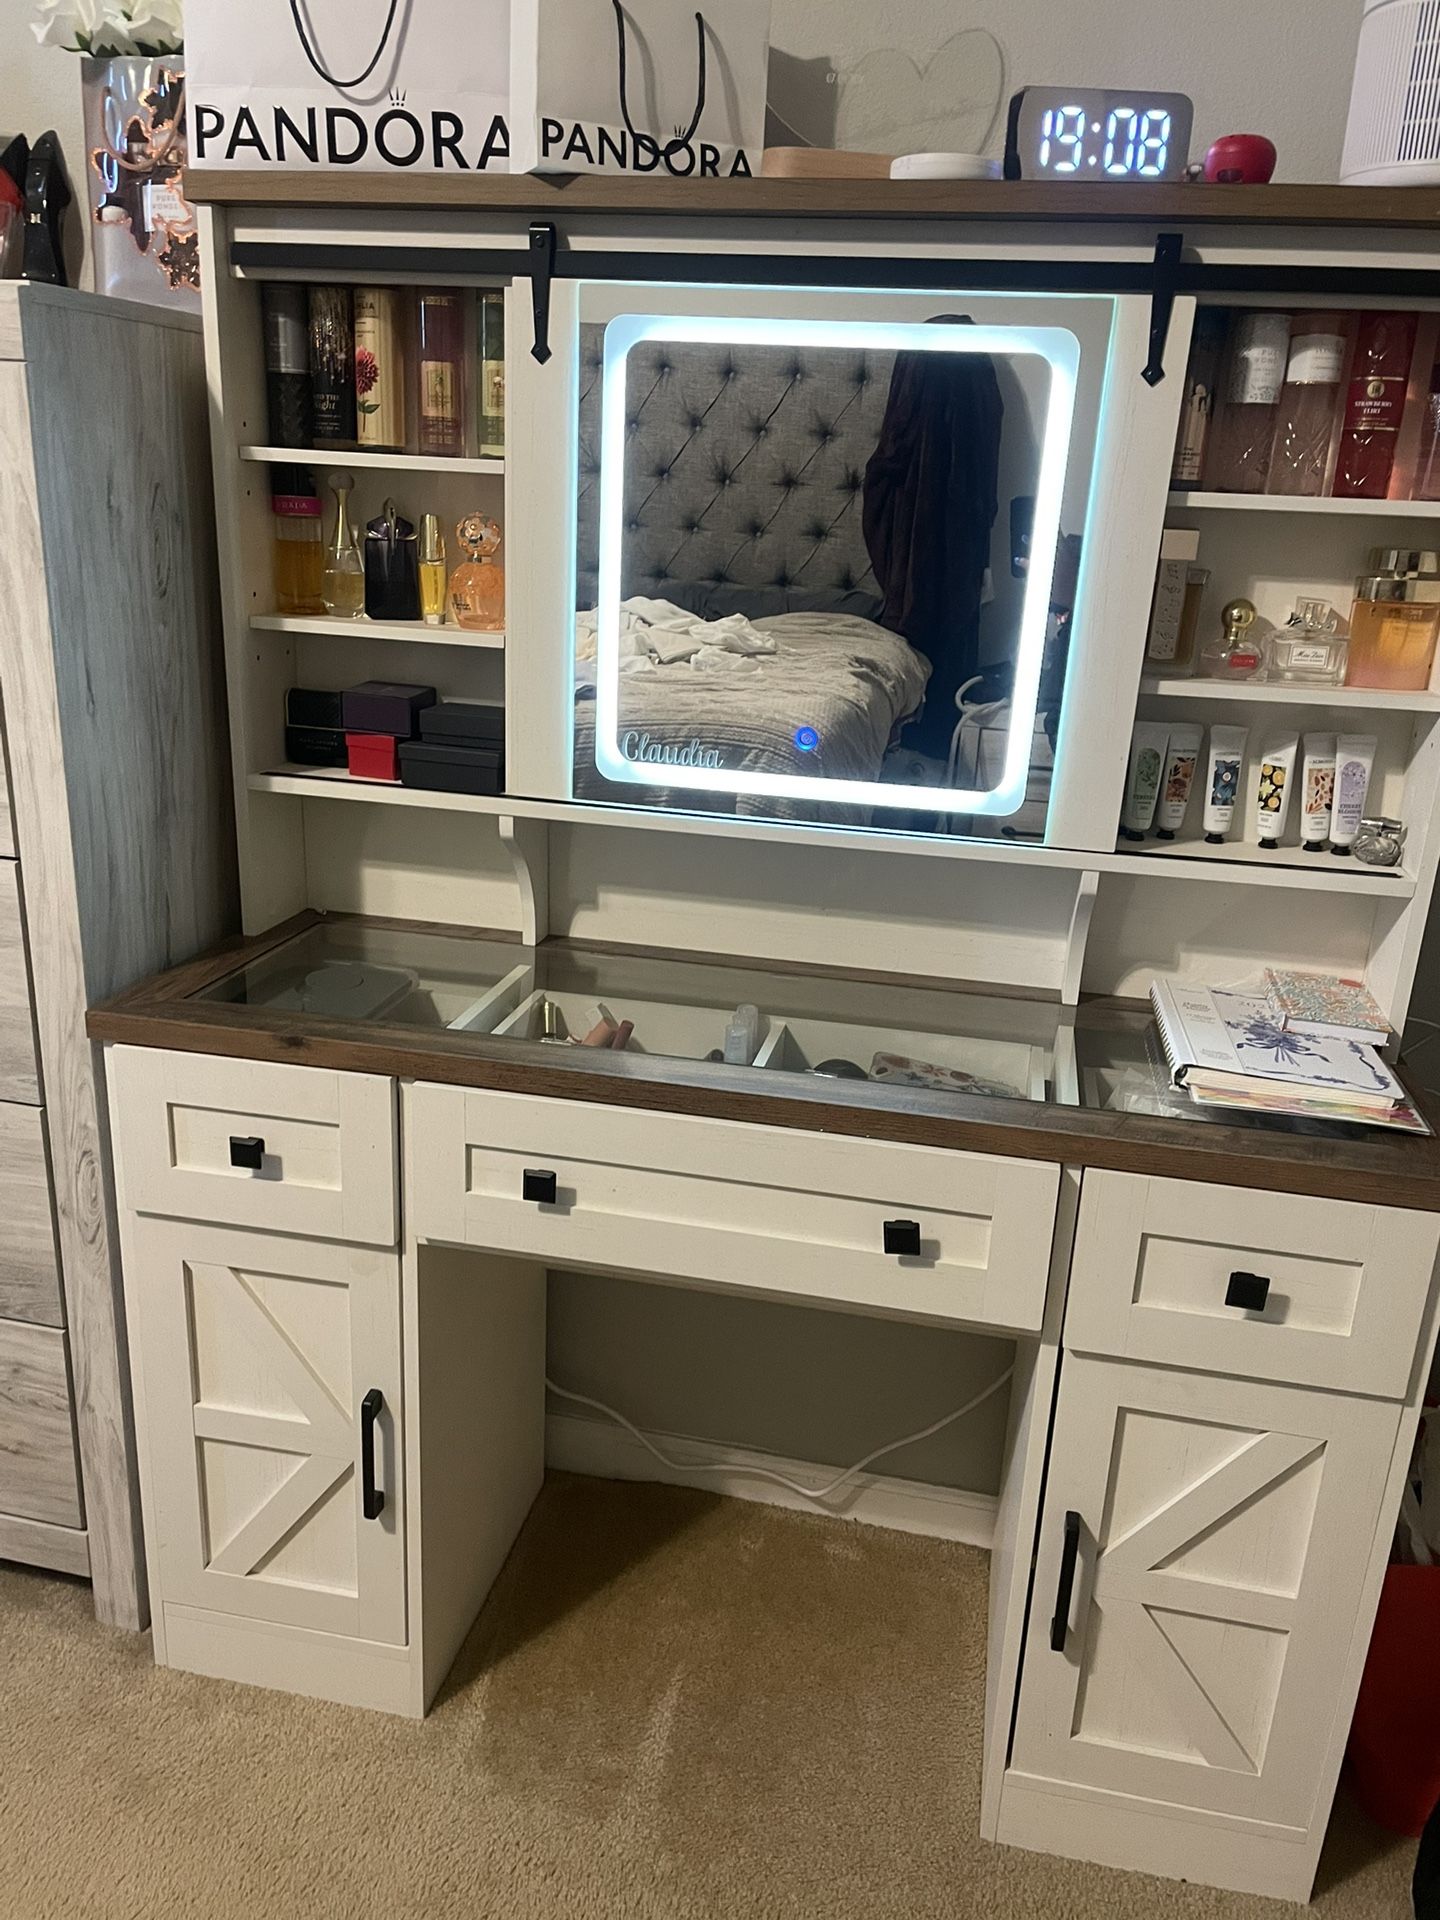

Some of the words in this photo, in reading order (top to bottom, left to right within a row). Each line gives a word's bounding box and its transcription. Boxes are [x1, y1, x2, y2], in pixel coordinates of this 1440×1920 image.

[194, 103, 510, 170] PANDORA
[541, 117, 753, 178] PANDORA
[1039, 105, 1171, 176] 19:08
[622, 730, 724, 768] Claudia
